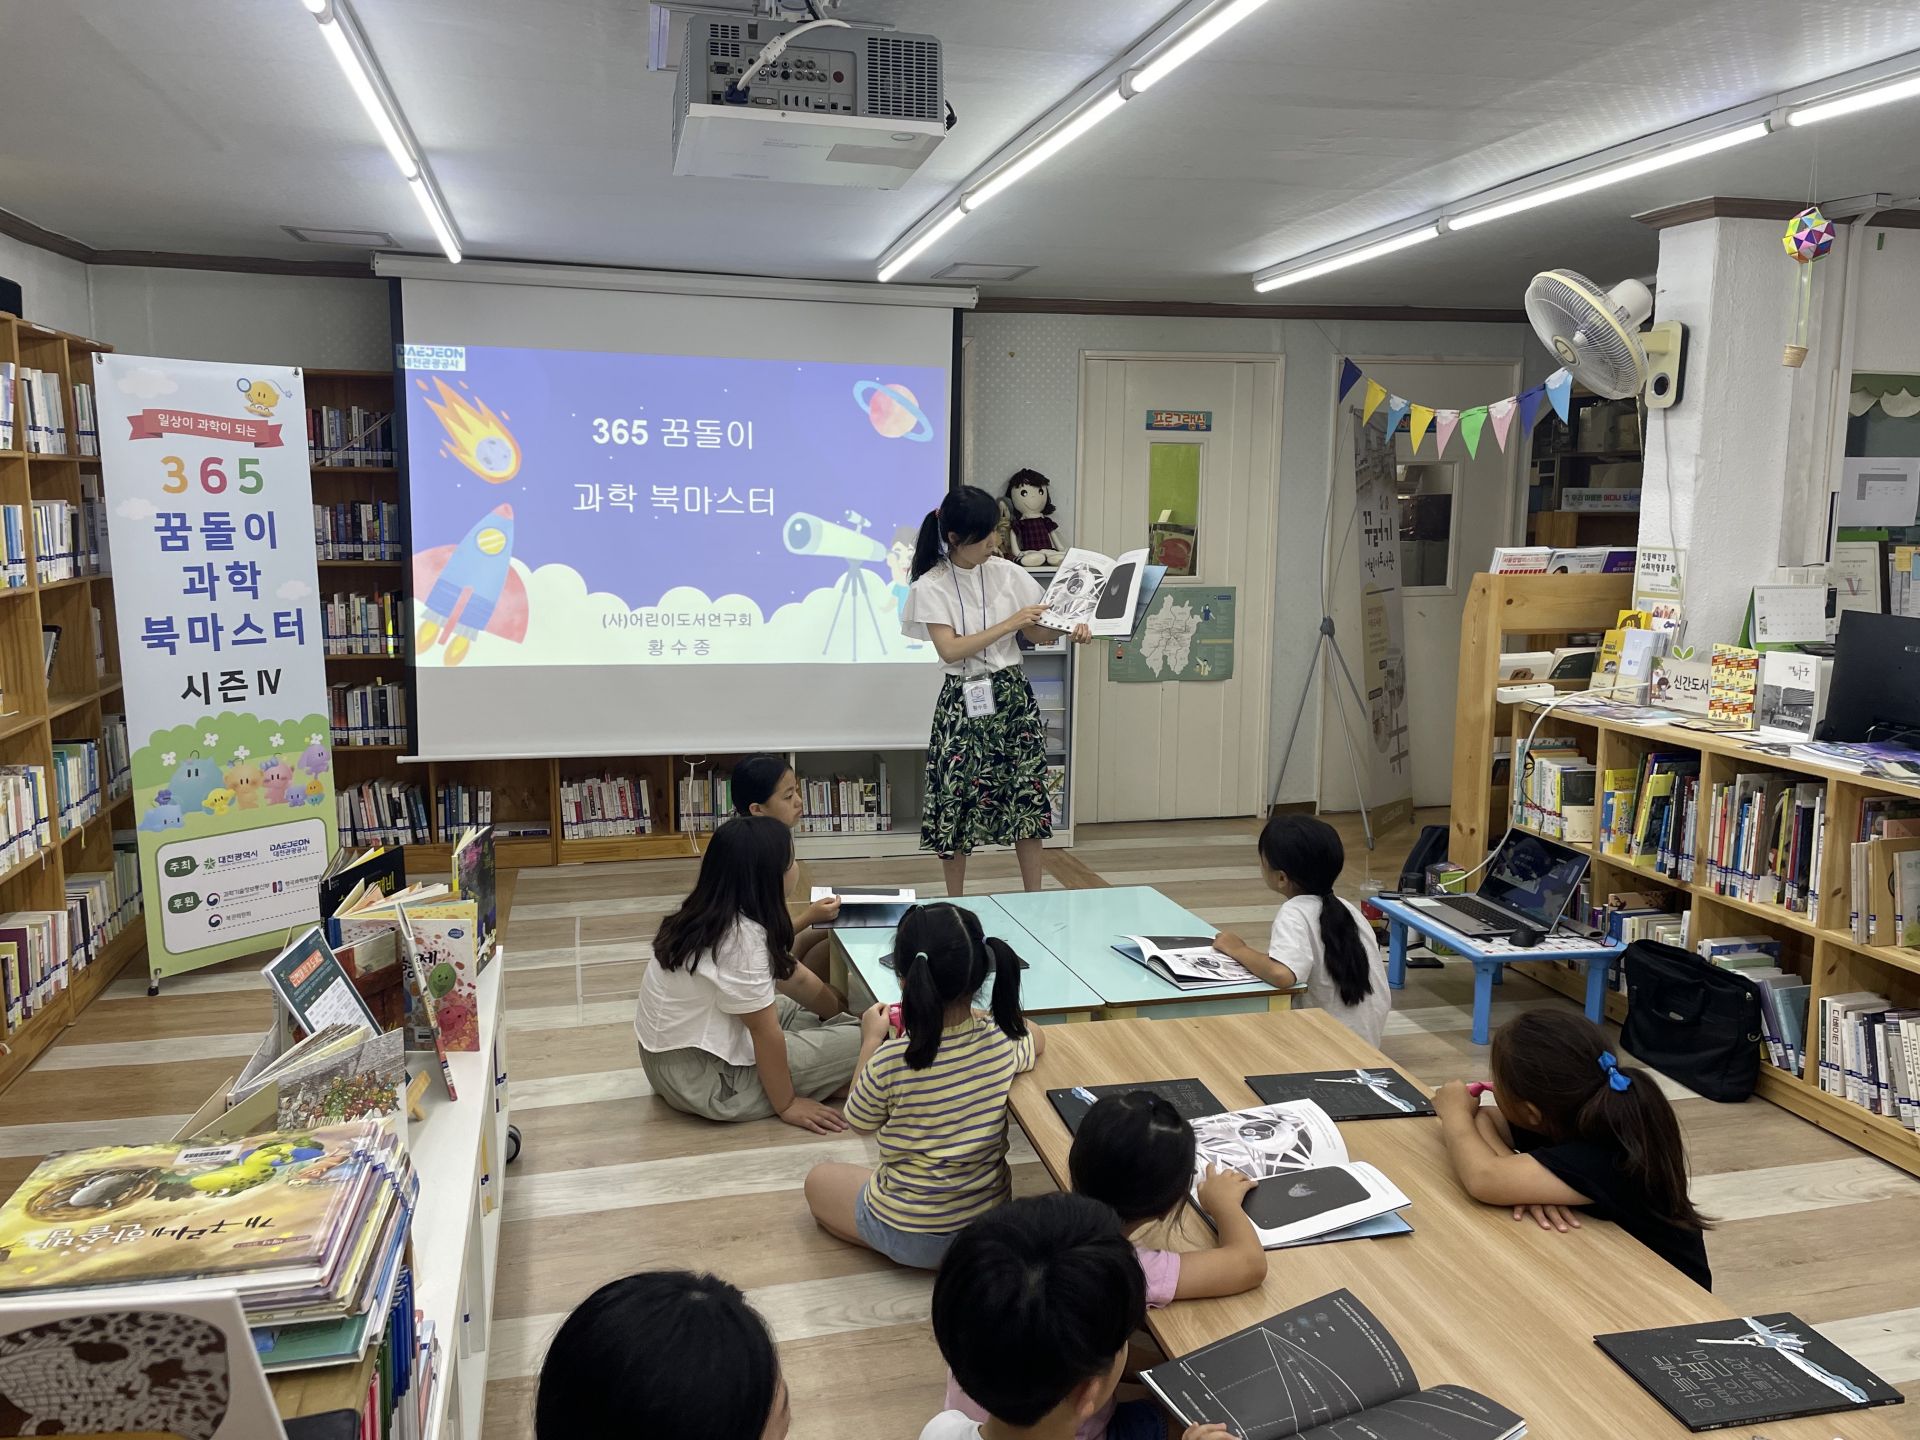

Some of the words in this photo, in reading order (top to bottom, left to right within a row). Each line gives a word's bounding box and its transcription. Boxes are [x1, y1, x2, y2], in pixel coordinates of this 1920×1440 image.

[157, 413, 193, 430] 일상이
[197, 418, 231, 435] 과학이
[235, 424, 257, 438] 되는
[592, 417, 649, 445] 365
[660, 418, 753, 450] 꿈돌이
[160, 455, 264, 495] 365
[572, 482, 638, 513] 과학
[651, 484, 774, 516] 북마스터
[154, 511, 277, 551] 꿈돌이
[182, 561, 261, 601] 과학
[141, 608, 304, 655] 북마스터
[602, 613, 752, 628] (사)어린이도서연구회
[181, 670, 248, 705] 시즌
[1674, 675, 1709, 695] 신간도서
[218, 850, 258, 864] 대전광역시
[269, 838, 310, 851] DAEJEON
[169, 860, 191, 873] 주최
[173, 896, 194, 909] 후원
[39, 1223, 147, 1249] 한솥밥
[1651, 1355, 1716, 1410] 하늘에는
